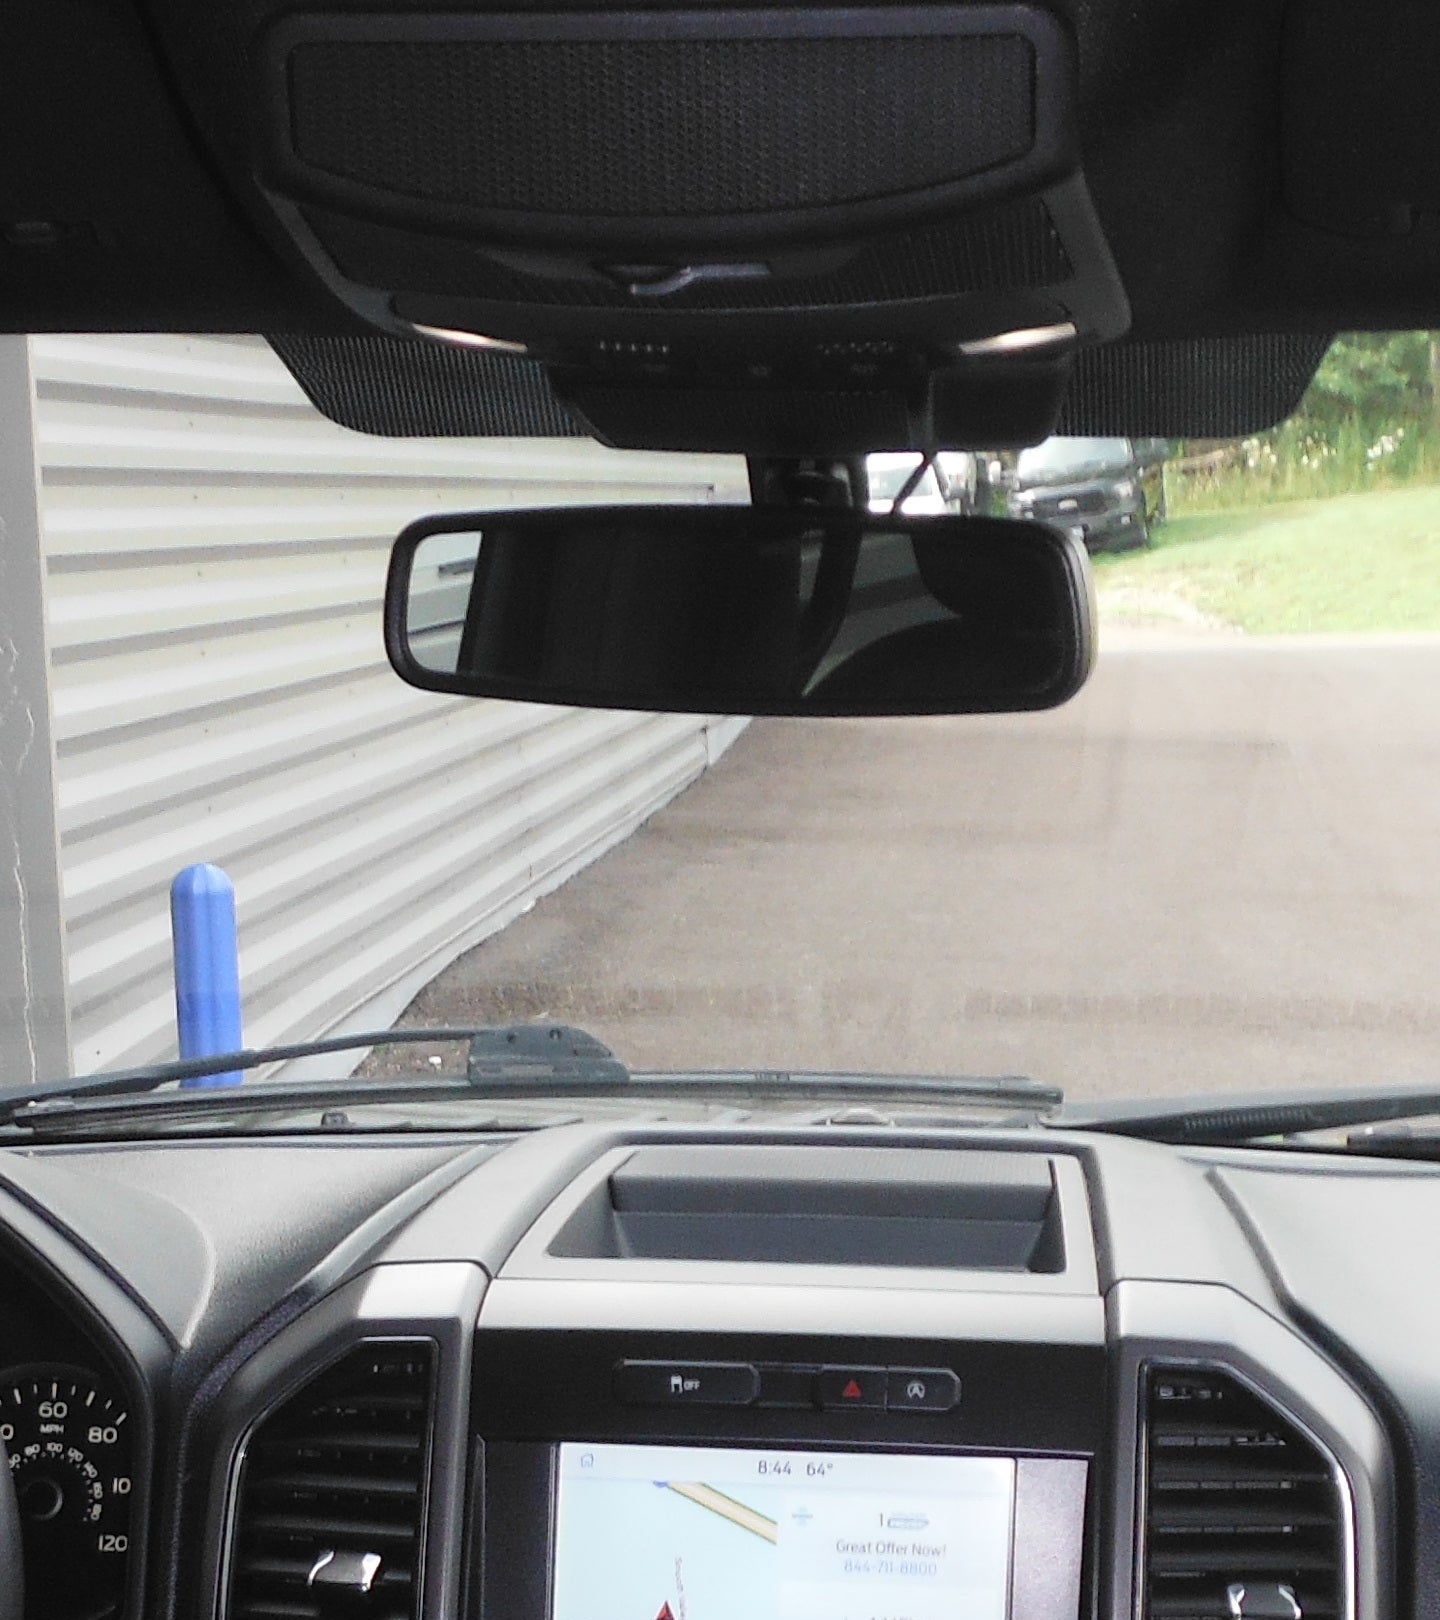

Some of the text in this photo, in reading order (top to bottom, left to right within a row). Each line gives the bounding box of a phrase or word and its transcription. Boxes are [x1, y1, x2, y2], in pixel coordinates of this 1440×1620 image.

[38, 1401, 68, 1419] 60
[0, 1422, 15, 1441] 0
[39, 1423, 64, 1435] MPH
[87, 1425, 118, 1444] 80
[98, 1534, 129, 1553] 120
[835, 1538, 872, 1555] Great
[875, 1540, 909, 1556] Offer
